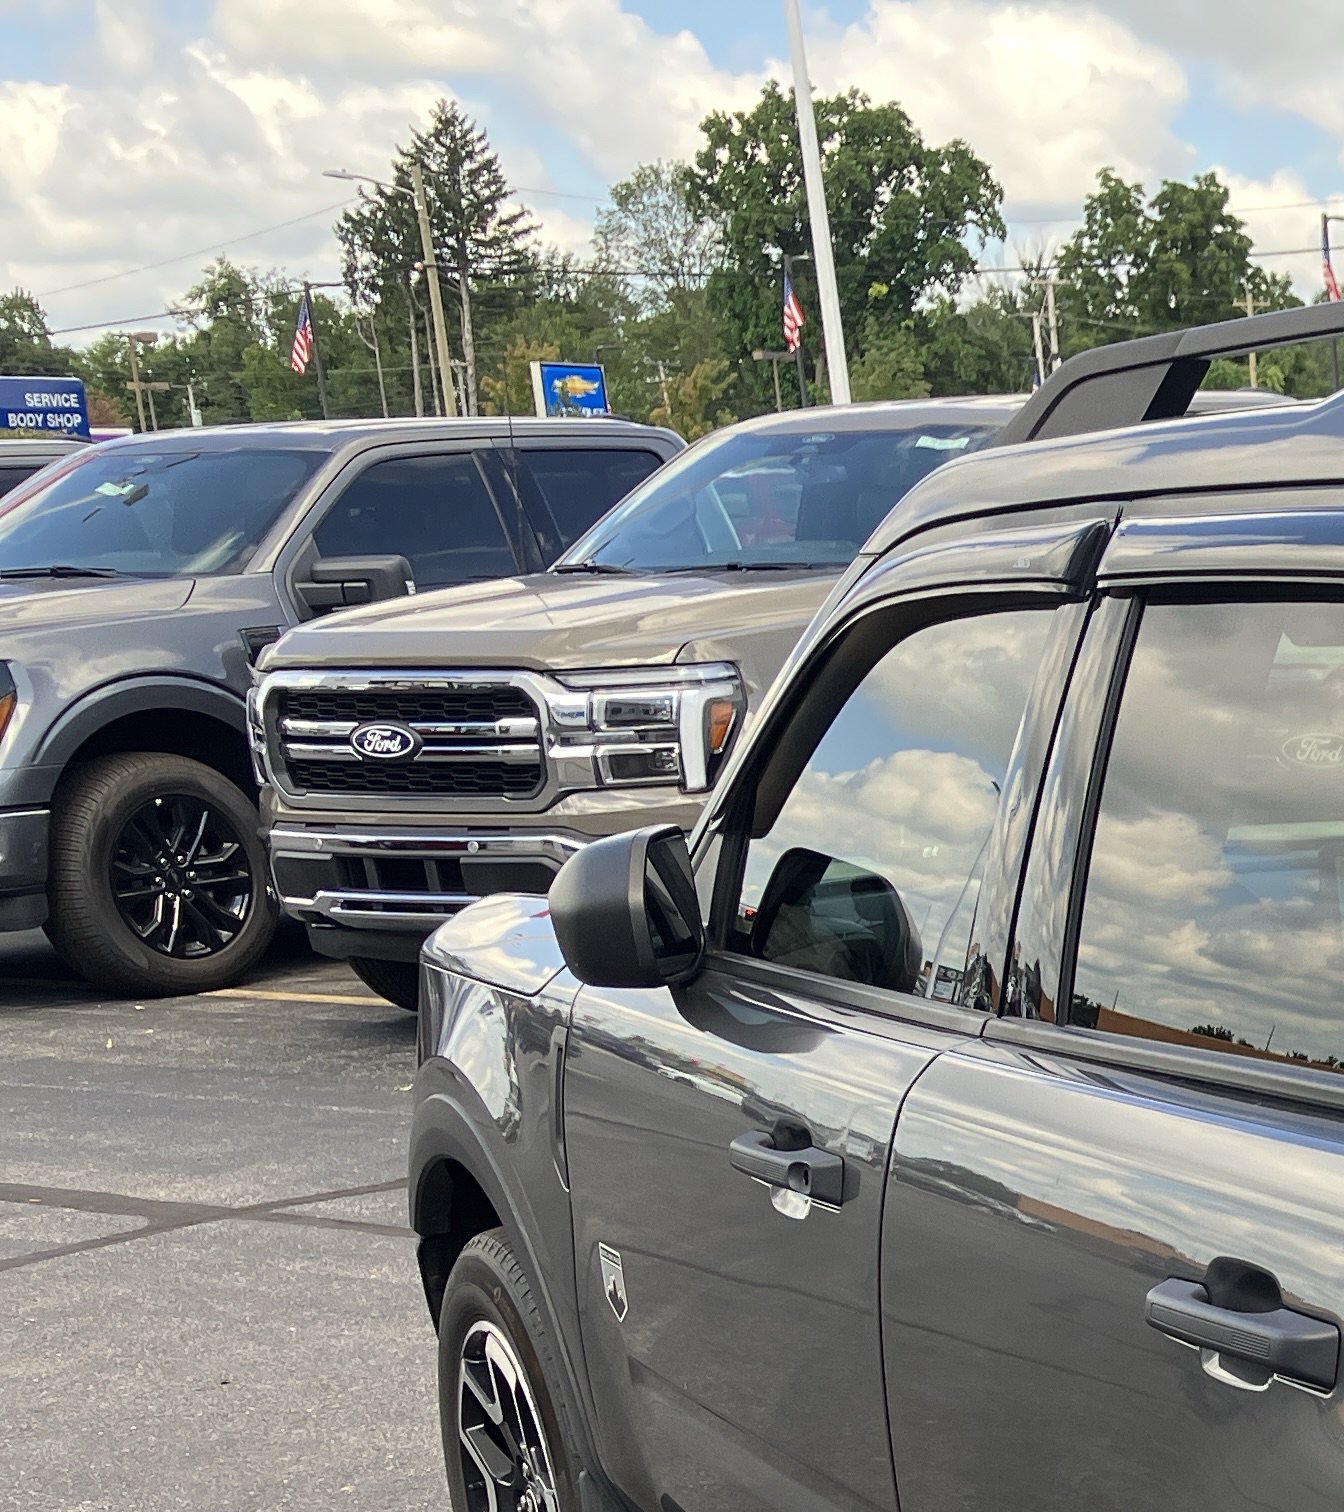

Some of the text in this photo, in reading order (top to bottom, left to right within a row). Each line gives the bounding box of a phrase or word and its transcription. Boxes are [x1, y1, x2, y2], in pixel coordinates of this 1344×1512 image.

[24, 393, 80, 408] SERVICE
[8, 413, 82, 427] BODY SHOP
[363, 729, 402, 752] Ford
[1296, 738, 1344, 761] Ford
